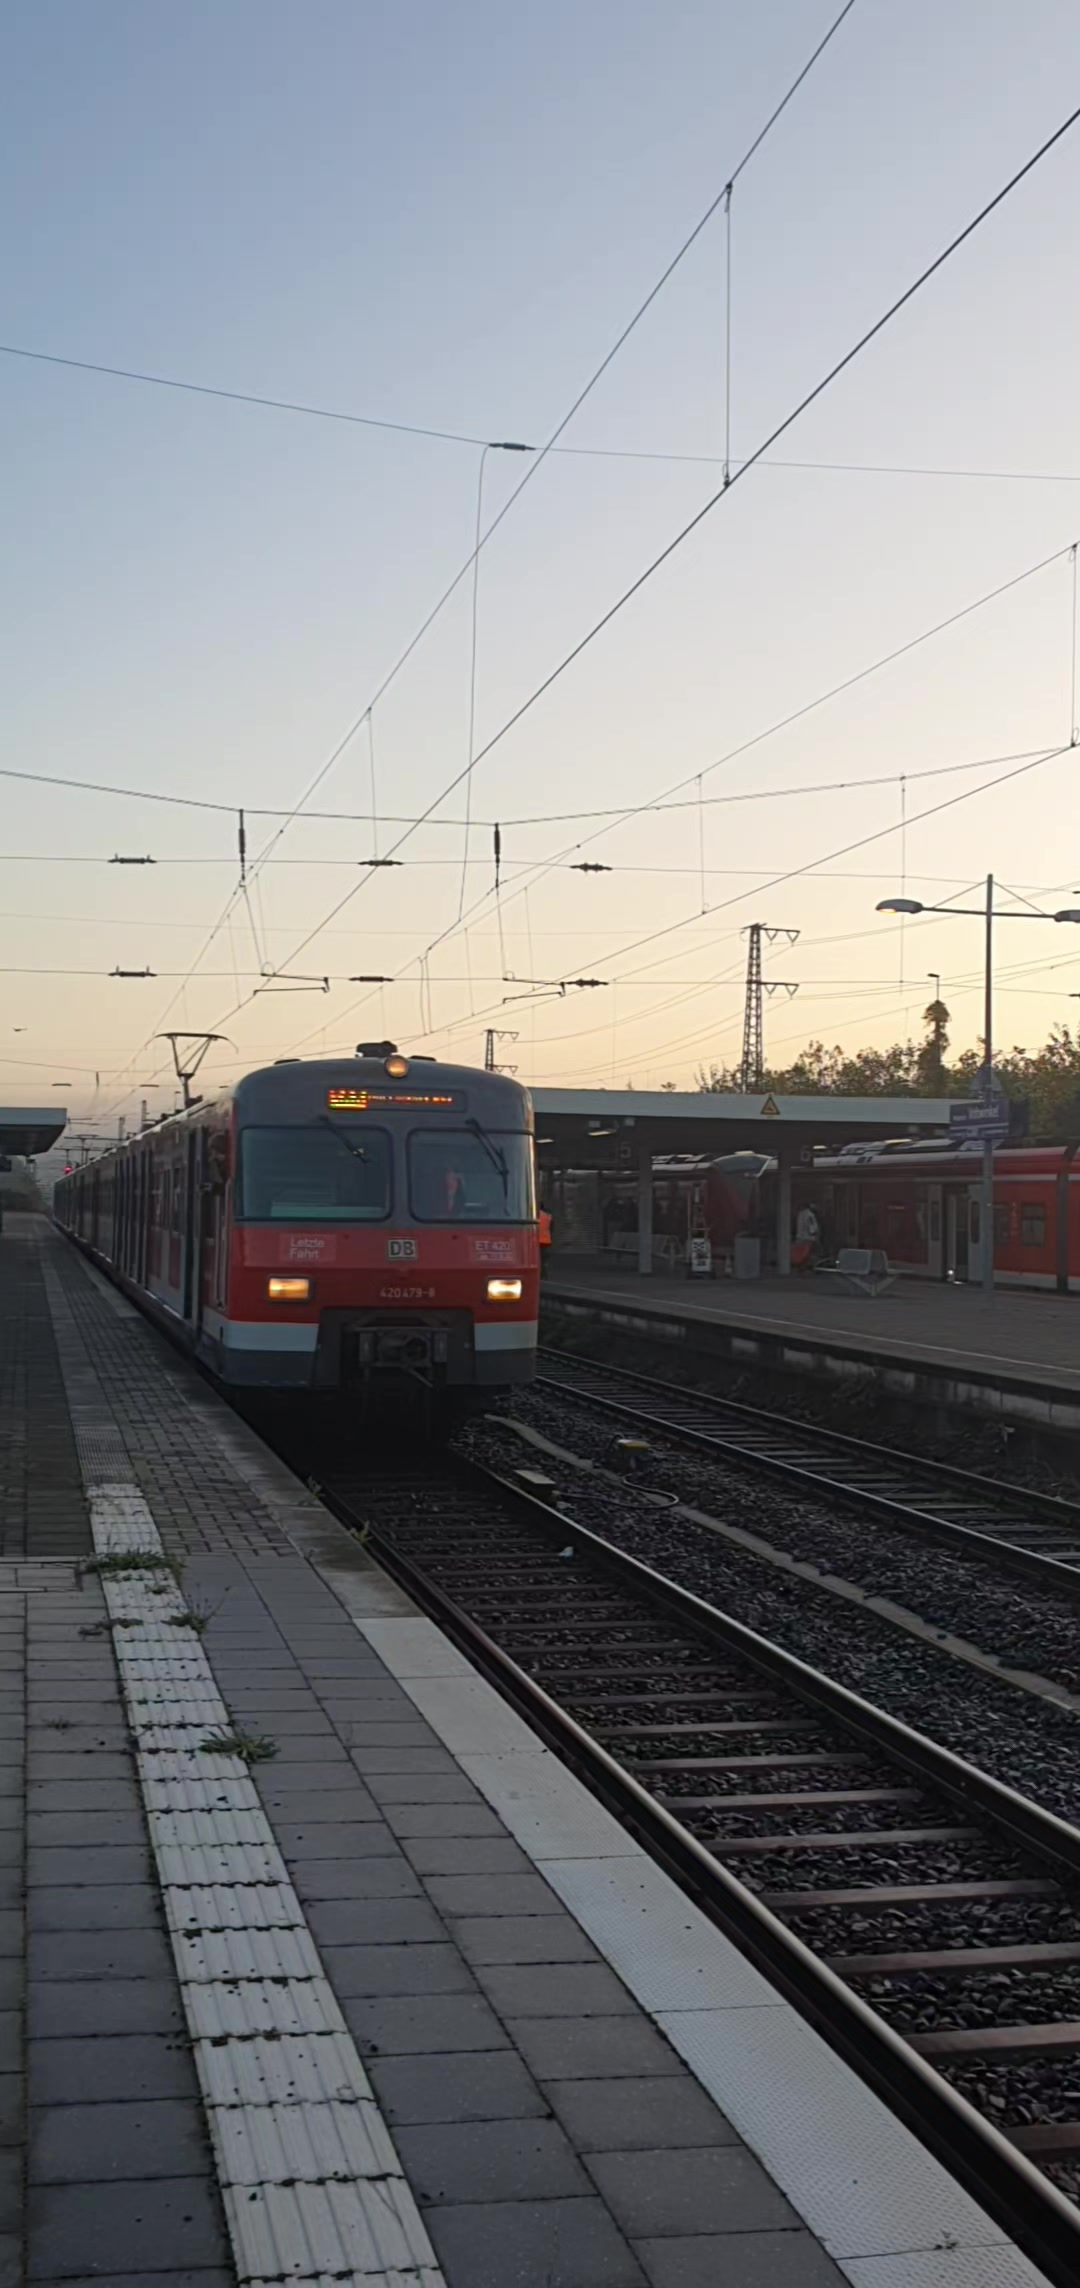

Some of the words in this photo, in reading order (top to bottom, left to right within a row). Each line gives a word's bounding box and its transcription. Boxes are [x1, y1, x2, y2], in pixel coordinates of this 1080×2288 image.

[290, 1235, 325, 1248] Letzte
[474, 1240, 489, 1251] ET
[290, 1247, 320, 1259] Fahrt
[390, 1241, 414, 1256] DB
